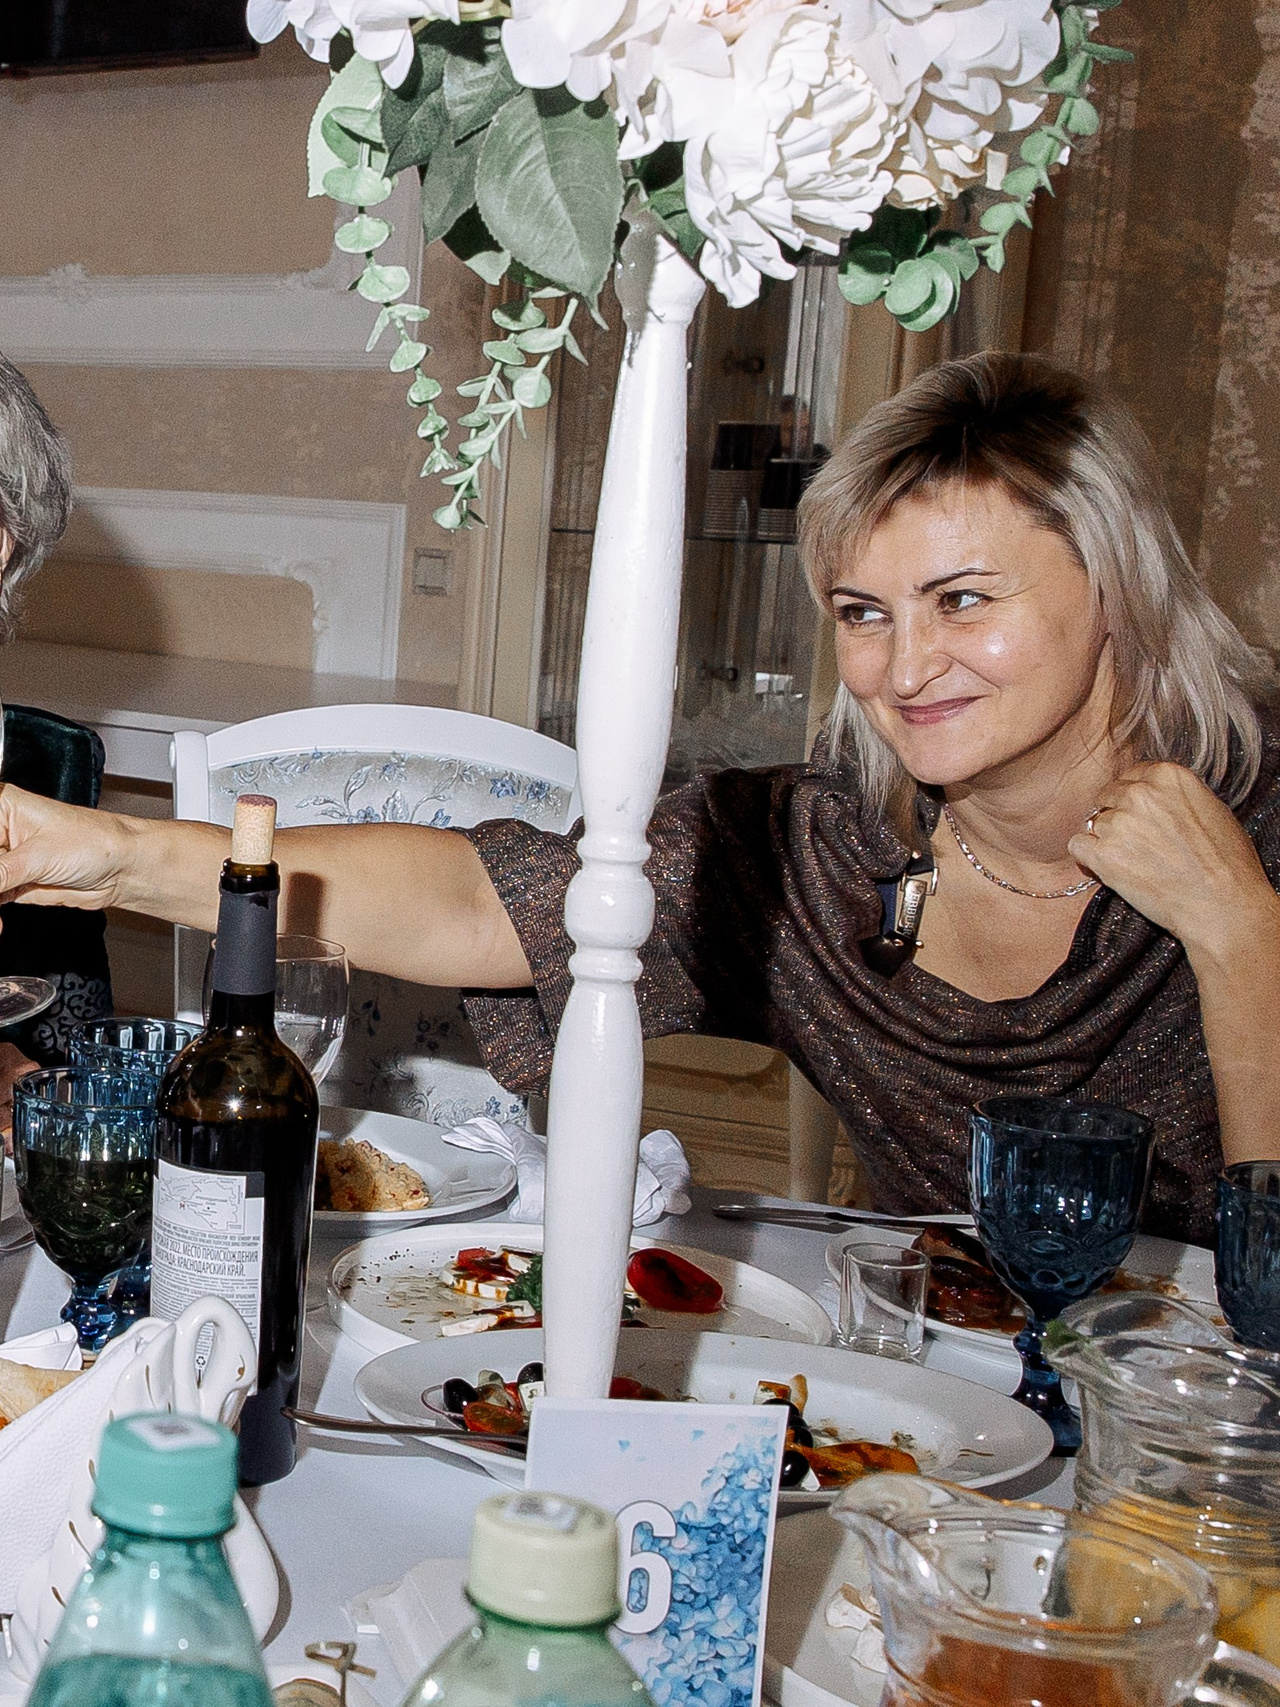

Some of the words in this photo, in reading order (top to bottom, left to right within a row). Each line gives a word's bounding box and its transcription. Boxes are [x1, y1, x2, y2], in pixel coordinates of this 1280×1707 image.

[183, 1243, 201, 1259] МЕСТО
[202, 1247, 259, 1263] ПРОИСХОЖДЕНИЯ
[177, 1256, 226, 1276] КРАСНОДАРСКИЙ
[227, 1263, 246, 1277] КРАЙ.
[614, 1500, 678, 1635] 6
